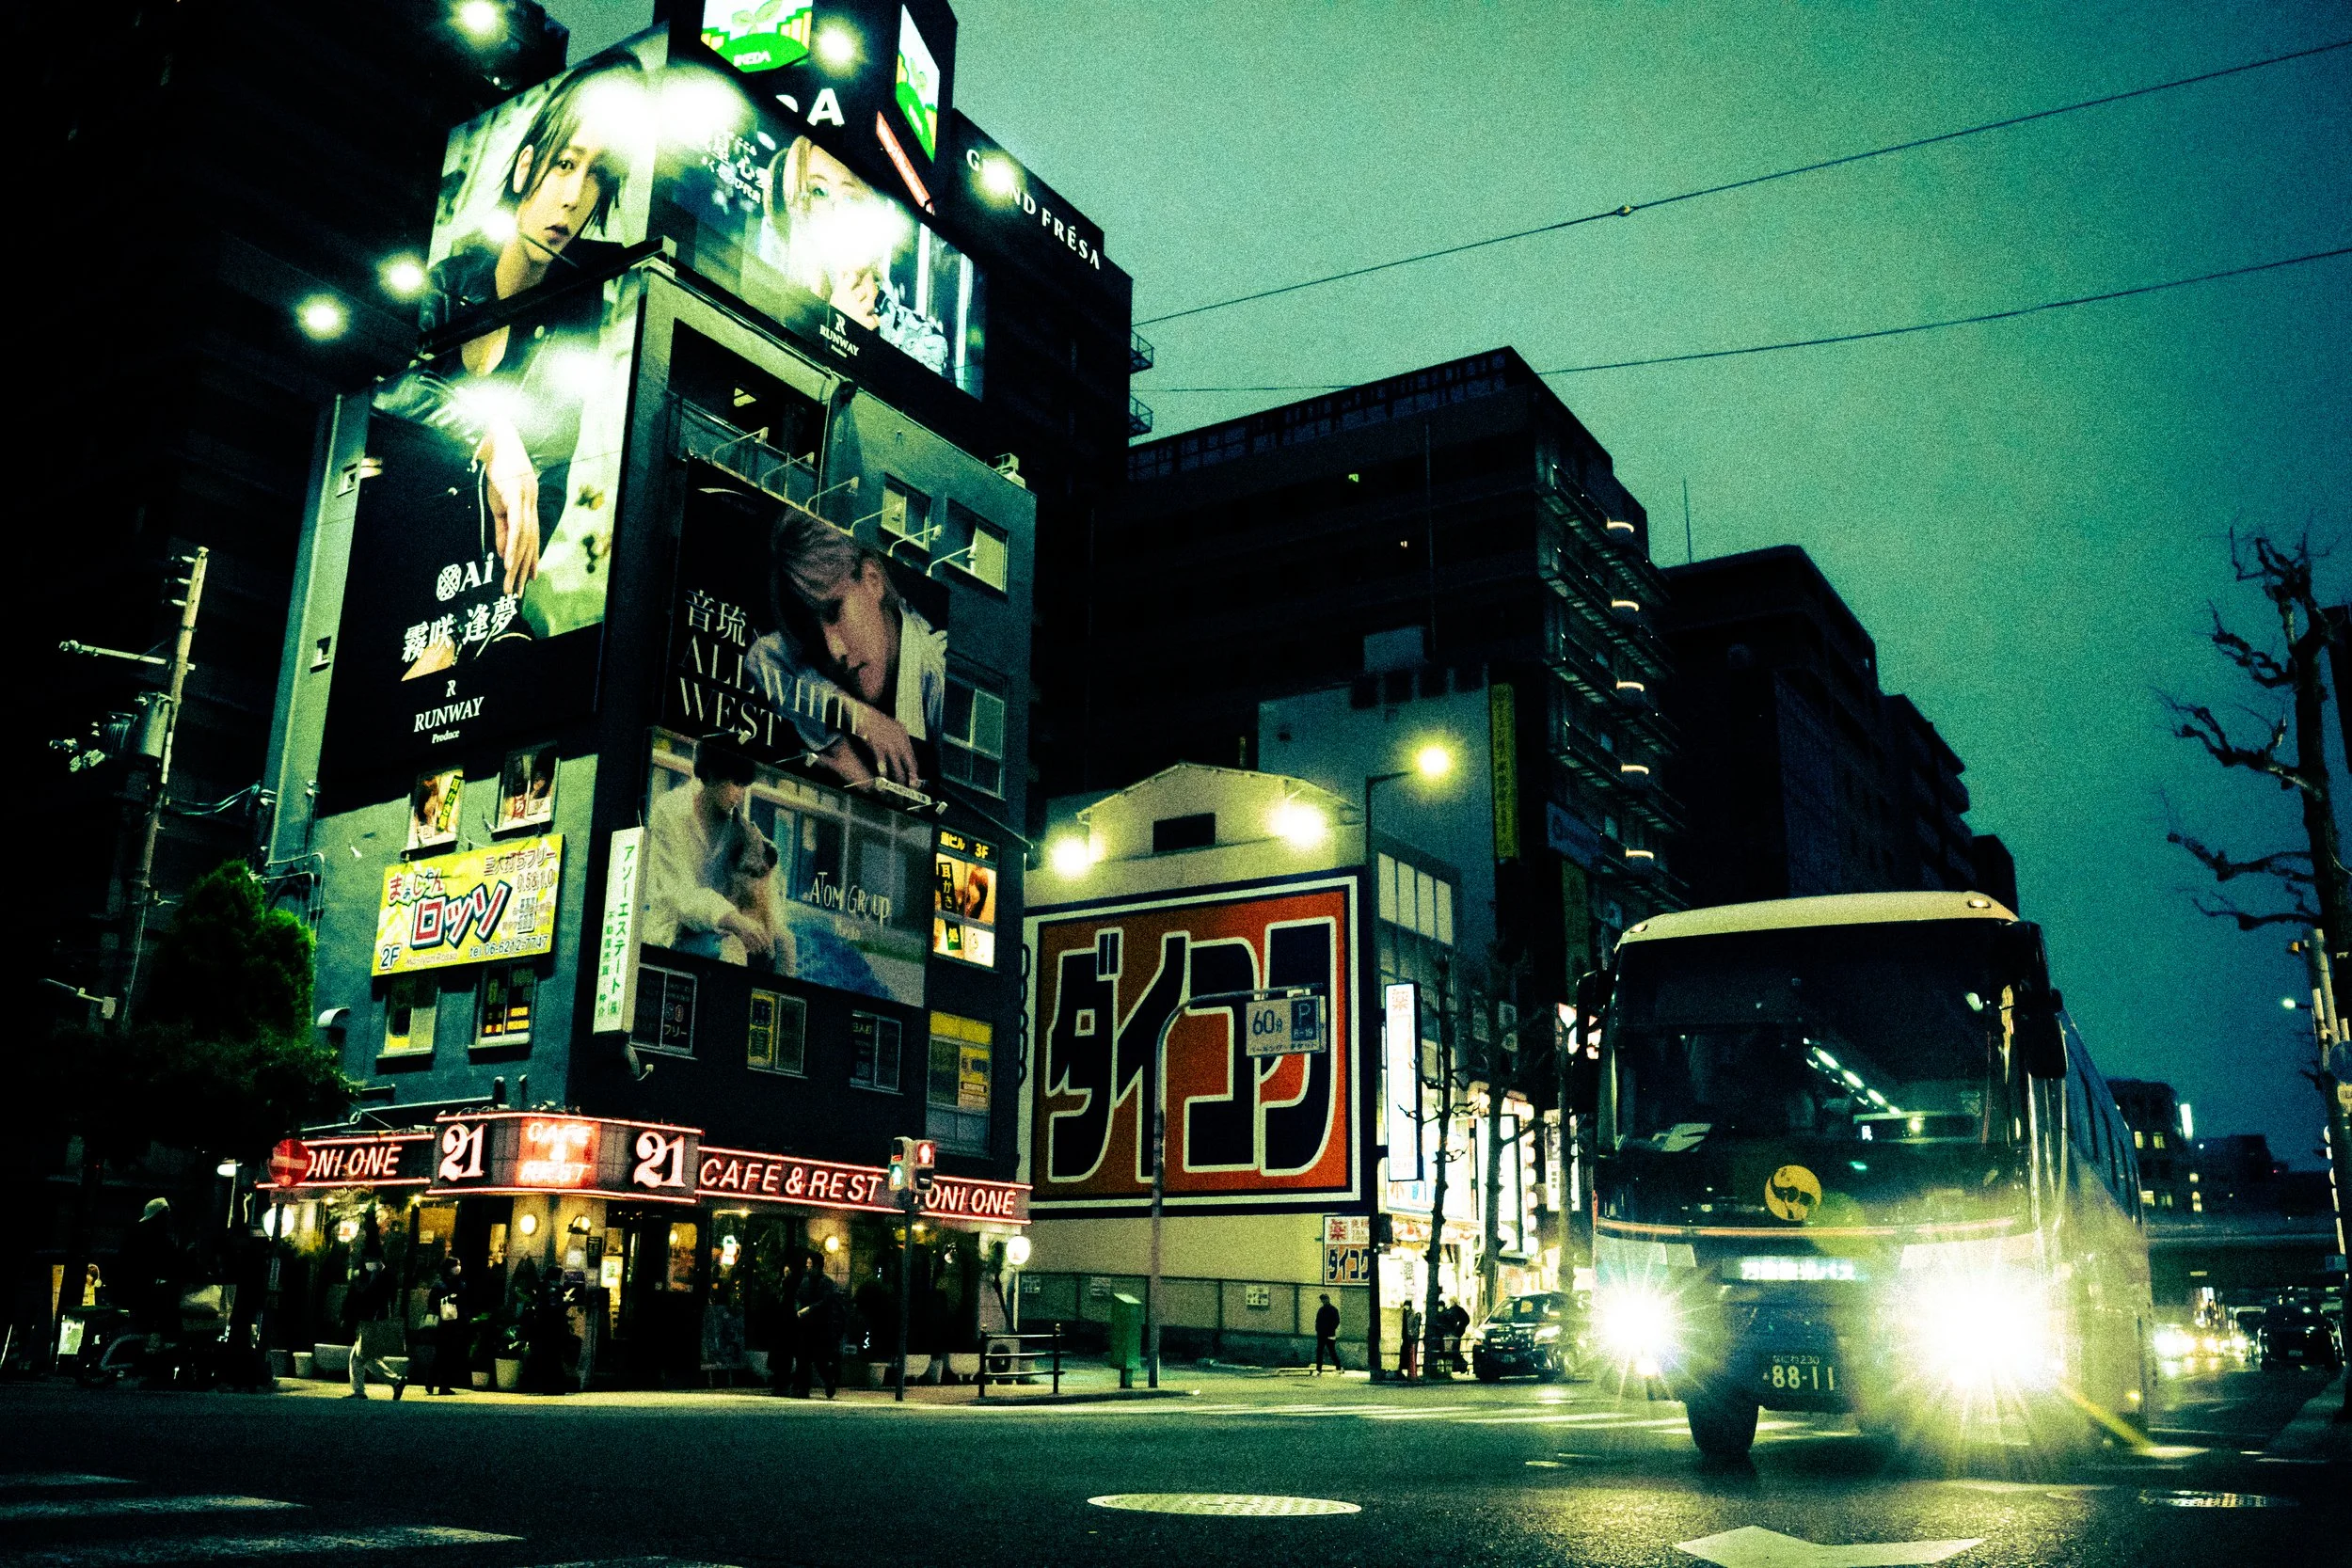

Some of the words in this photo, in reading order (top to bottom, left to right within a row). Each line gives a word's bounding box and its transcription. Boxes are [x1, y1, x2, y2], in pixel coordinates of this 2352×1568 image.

[966, 149, 1037, 215] GND
[819, 324, 860, 356] RUNWAY
[684, 589, 747, 647] 音琉
[678, 634, 756, 694] ALL
[413, 696, 485, 733] RUNWAY
[679, 676, 783, 747] WEST
[431, 730, 461, 744] Produce
[975, 843, 989, 859] 3F
[808, 871, 845, 911] ATOM
[411, 880, 512, 949] ロッソ
[381, 946, 401, 968] 2F
[662, 1023, 688, 1037] フリー
[1298, 1003, 1311, 1028] P
[348, 1147, 403, 1177] ONE
[438, 1123, 488, 1181] 21
[633, 1131, 687, 1189] 21
[970, 1189, 1017, 1216] ONE
[1329, 1219, 1348, 1241] 薬
[1772, 1365, 1835, 1392] 88-11
